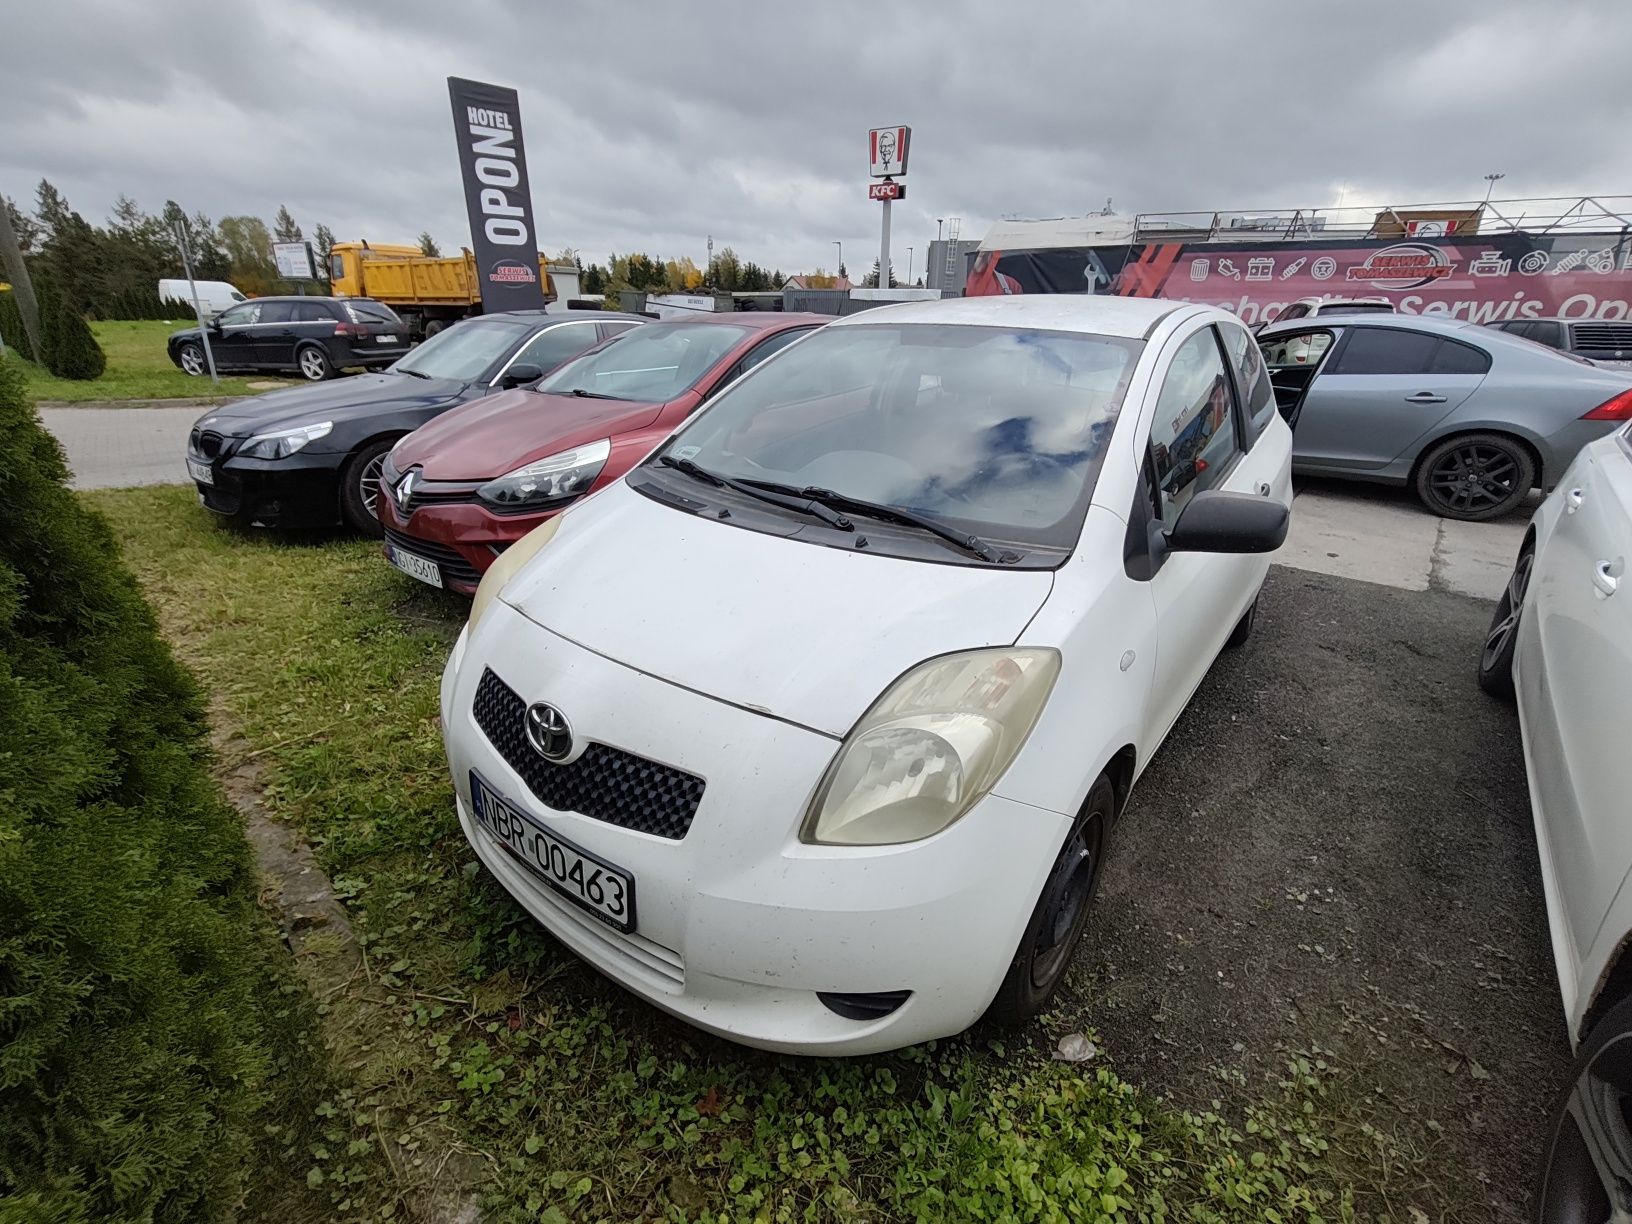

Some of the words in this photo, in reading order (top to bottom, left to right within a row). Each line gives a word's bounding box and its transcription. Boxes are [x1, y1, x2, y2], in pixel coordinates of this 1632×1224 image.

[467, 106, 513, 130] HOTEL
[469, 124, 528, 246] OPON
[871, 185, 895, 197] KFC
[497, 266, 527, 275] SERWIS
[1371, 254, 1431, 268] SERWIS
[1399, 291, 1544, 325] Serwis
[1557, 293, 1632, 319] Op
[481, 787, 527, 856] NBR
[534, 833, 626, 916] 00463
